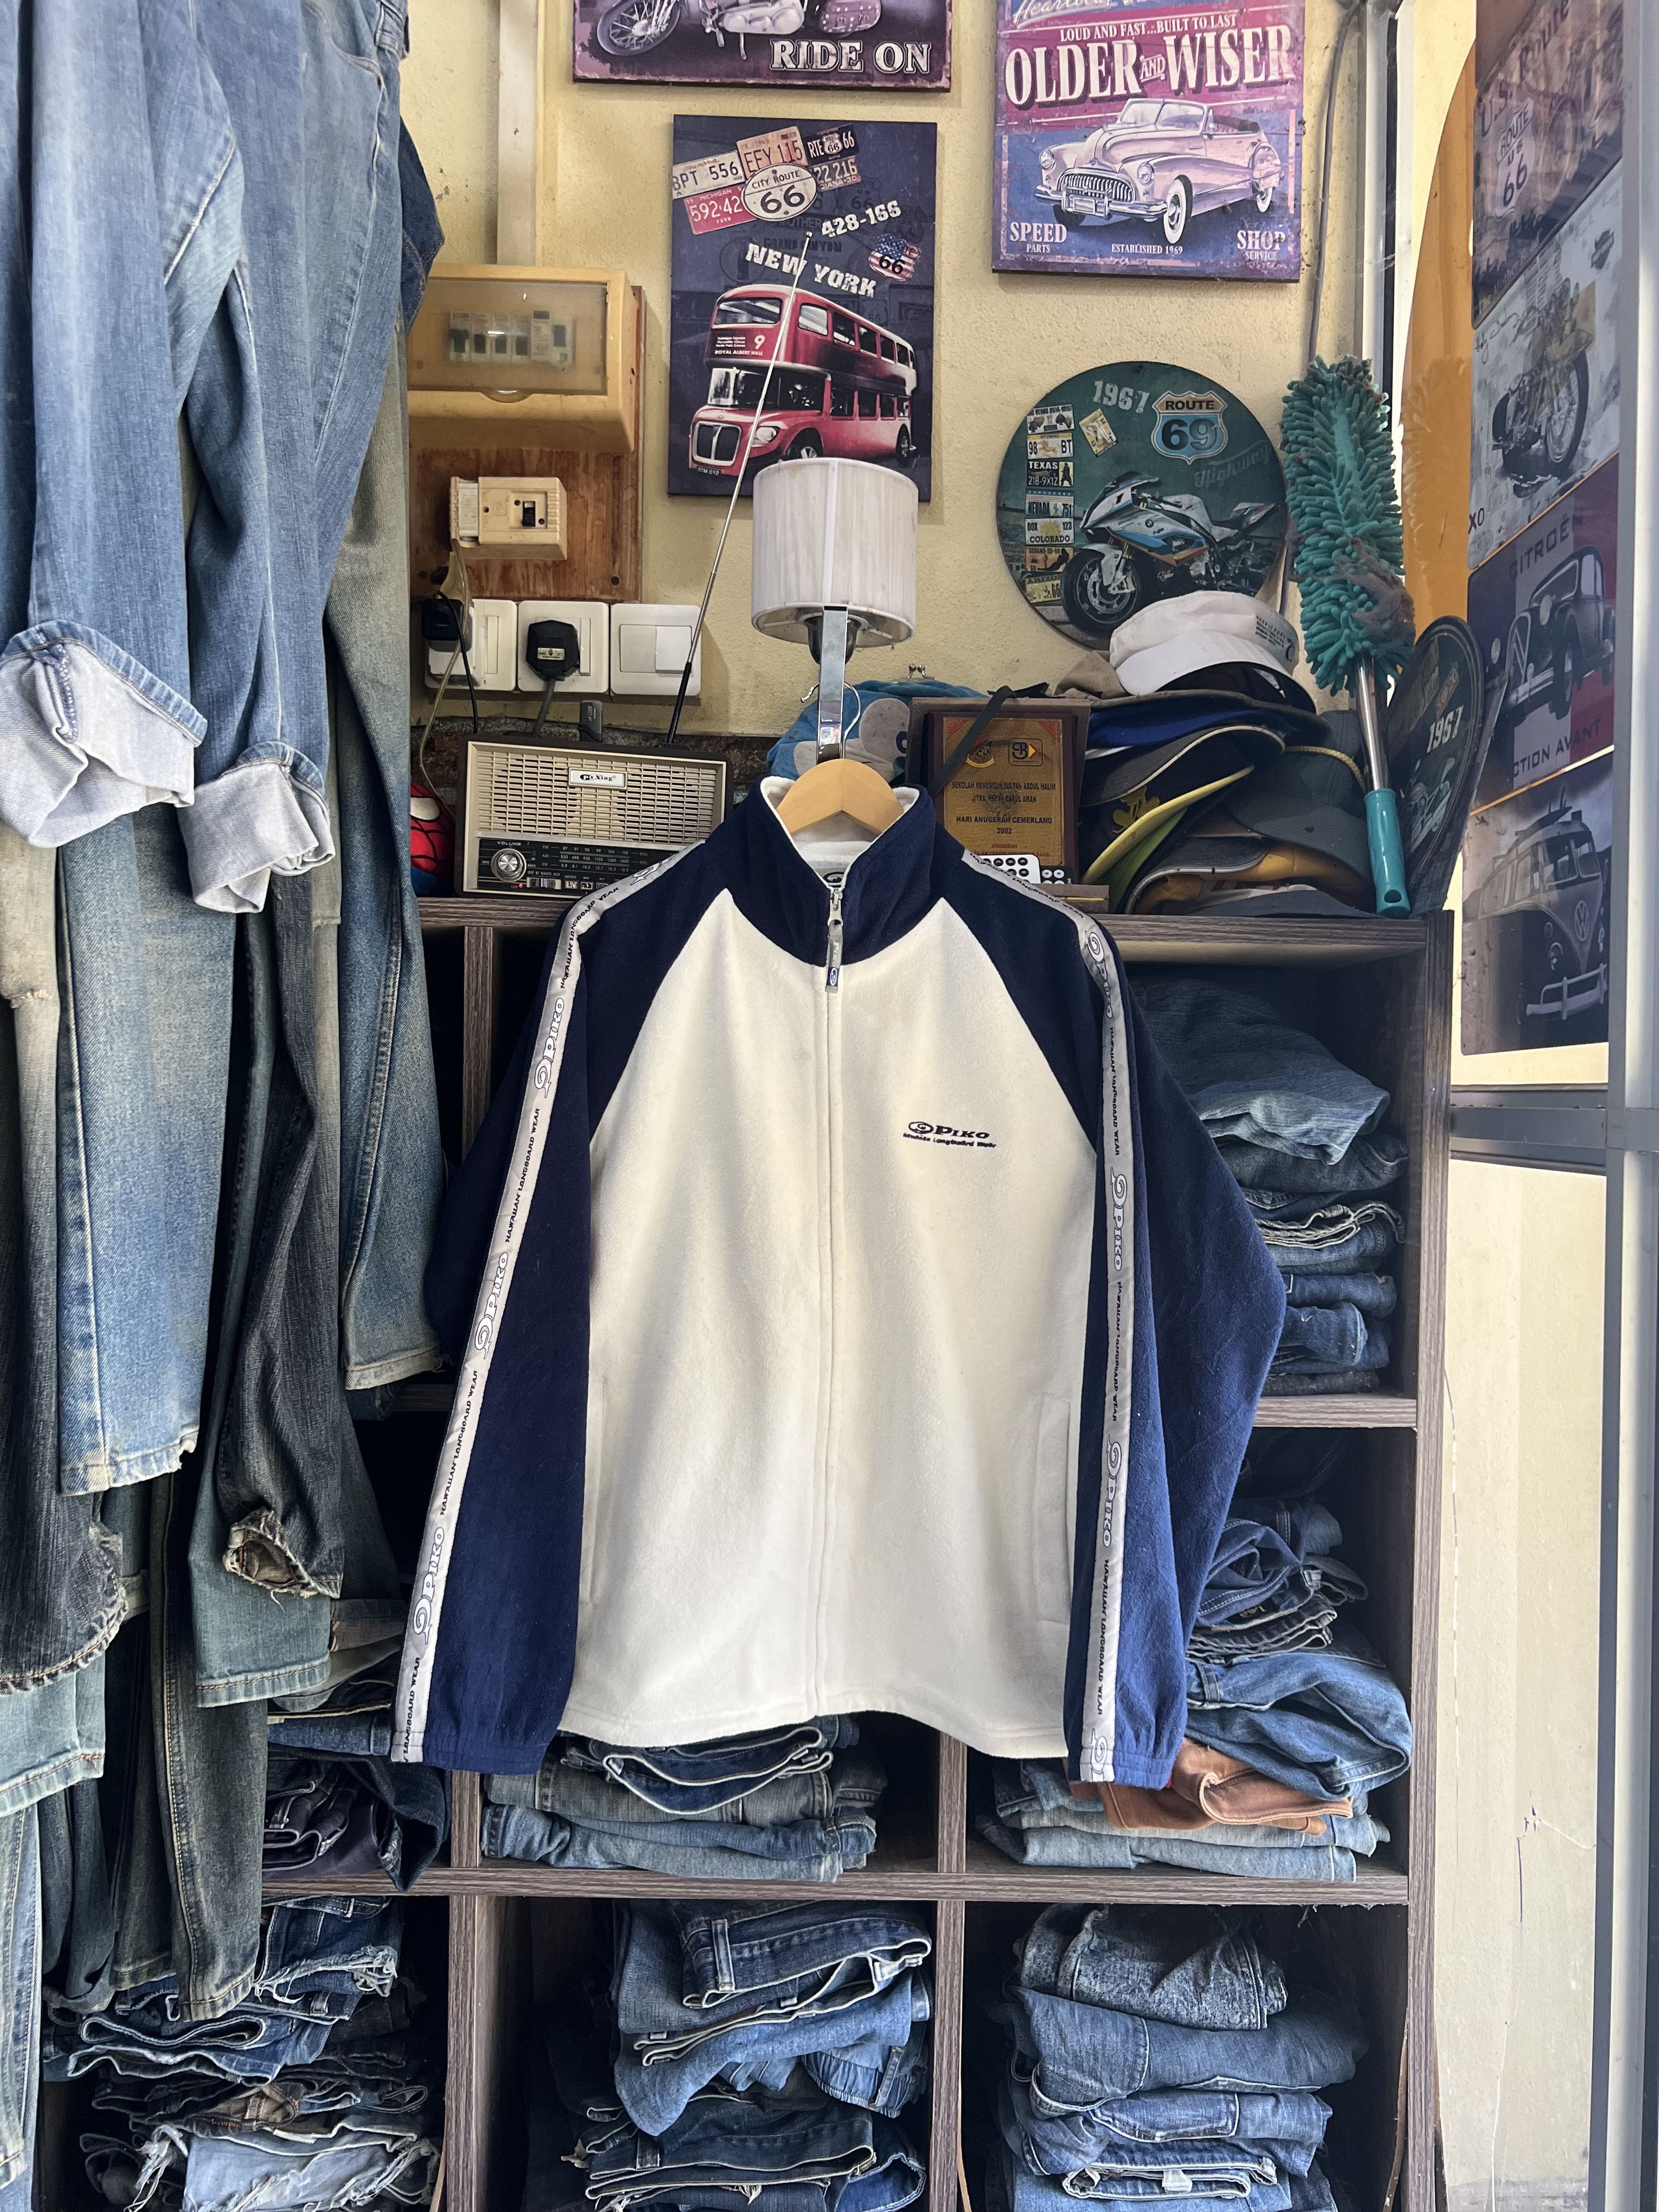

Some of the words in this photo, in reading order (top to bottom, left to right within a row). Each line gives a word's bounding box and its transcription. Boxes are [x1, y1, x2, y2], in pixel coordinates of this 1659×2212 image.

[1060, 28, 1090, 42] LOUD
[1094, 25, 1117, 39] AND
[1192, 16, 1208, 30] TO
[1210, 14, 1237, 28] LAST
[771, 39, 864, 73] RIDE
[874, 42, 931, 74] ON
[1005, 39, 1141, 106] OLDER
[1140, 56, 1166, 81] AND
[1164, 24, 1296, 91] WISER
[1501, 102, 1528, 156] ROUTE
[777, 140, 803, 164] 115
[807, 140, 824, 158] RTE
[843, 131, 855, 149] 66
[828, 143, 839, 152] 66
[709, 161, 738, 180] 556
[752, 178, 769, 190] CITY
[773, 170, 800, 183] ROUTE
[833, 158, 857, 180] 216
[1503, 153, 1527, 207] 66
[700, 189, 732, 200] MICHIGAN
[760, 185, 805, 213] 66
[821, 200, 901, 237] 428-166
[1010, 222, 1067, 243] SPEED
[1026, 244, 1050, 254] PARTS
[1111, 244, 1163, 255] ESTABLISHED
[1165, 245, 1184, 255] 1969
[1237, 230, 1285, 250] SHOP
[879, 255, 903, 274] 66
[1244, 250, 1277, 261] SERVICE
[745, 243, 807, 276] NEW
[814, 264, 877, 298] YORK
[755, 335, 766, 349] 9
[1093, 381, 1149, 413] 1967
[1165, 400, 1215, 410] ROUTE
[1029, 442, 1038, 455] 98
[1061, 439, 1072, 454] BT
[1162, 419, 1217, 450] 69
[1029, 461, 1058, 469] TEXAS
[1028, 501, 1050, 516] NEVADA
[1426, 705, 1464, 753] 1967
[570, 900, 595, 941] LONGBOARD
[599, 887, 619, 901] WEAR
[543, 998, 564, 1063] PIKO
[933, 1125, 990, 1139] PIKO
[505, 1193, 521, 1243] HAWAIIAN
[518, 1137, 535, 1192] LONGBOARD
[531, 1108, 540, 1134] WEAR
[1113, 1203, 1124, 1271] PIKO
[484, 1252, 509, 1321] PIKO
[440, 1462, 456, 1516] HAWAIIAN
[454, 1400, 472, 1459] LONGBOARD
[468, 1370, 478, 1398] WEAR
[421, 1526, 445, 1602] PIKO
[1098, 1617, 1107, 1682] LONGBOARD
[403, 1690, 415, 1754] LONGBOARD
[410, 1657, 421, 1688] WEAR
